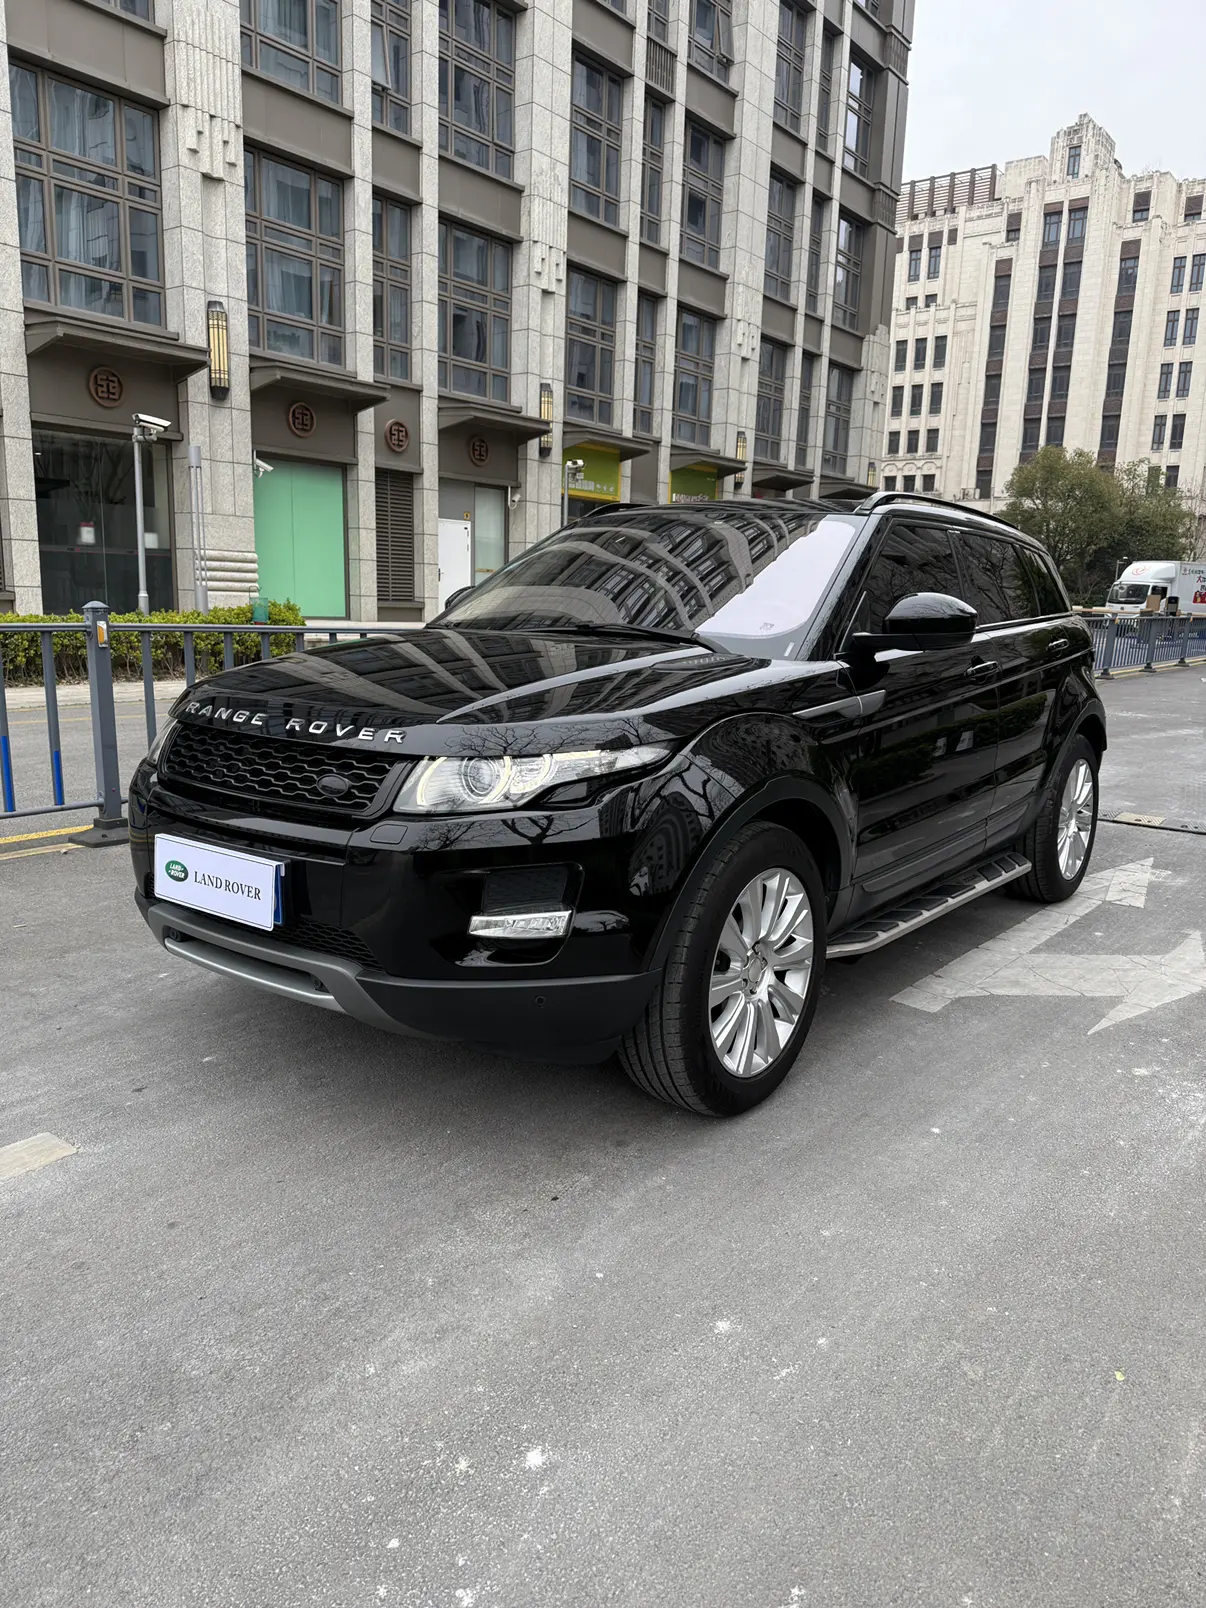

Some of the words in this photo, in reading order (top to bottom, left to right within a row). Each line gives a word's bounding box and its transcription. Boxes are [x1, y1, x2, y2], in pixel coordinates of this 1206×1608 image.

[185, 701, 268, 726] RANGE
[285, 717, 407, 744] ROVER
[169, 863, 182, 872] LAND
[194, 871, 223, 889] LAND
[224, 879, 262, 901] ROVER
